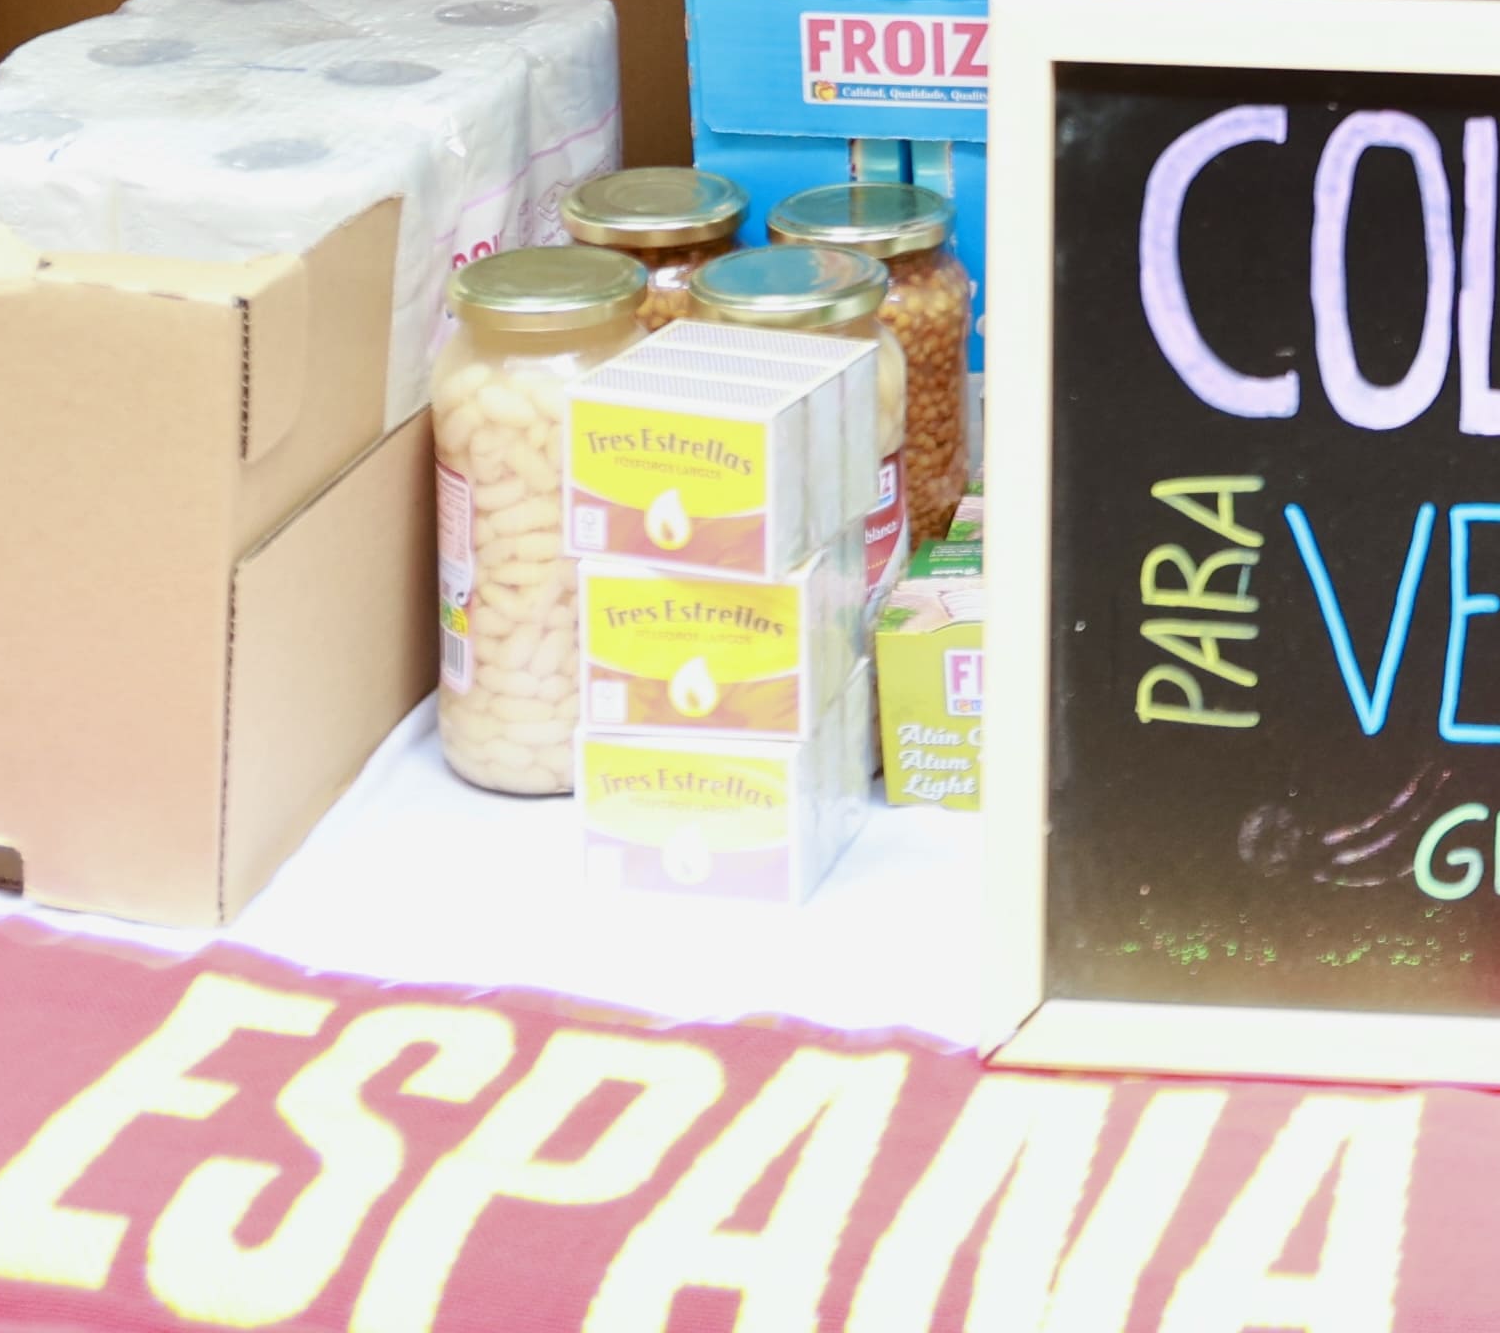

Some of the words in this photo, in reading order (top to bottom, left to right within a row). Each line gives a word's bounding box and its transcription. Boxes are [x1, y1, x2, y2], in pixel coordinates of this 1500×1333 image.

[807, 18, 988, 77] FROIZ
[584, 429, 636, 454] Tres
[640, 427, 754, 476] Estrellas
[604, 605, 658, 629] Tres
[662, 598, 786, 637] Estrellas
[1136, 474, 1266, 729] PARA
[898, 748, 972, 771] Atum
[599, 772, 652, 795] Tres
[656, 767, 774, 811] Estrellas
[902, 773, 978, 801] Light
